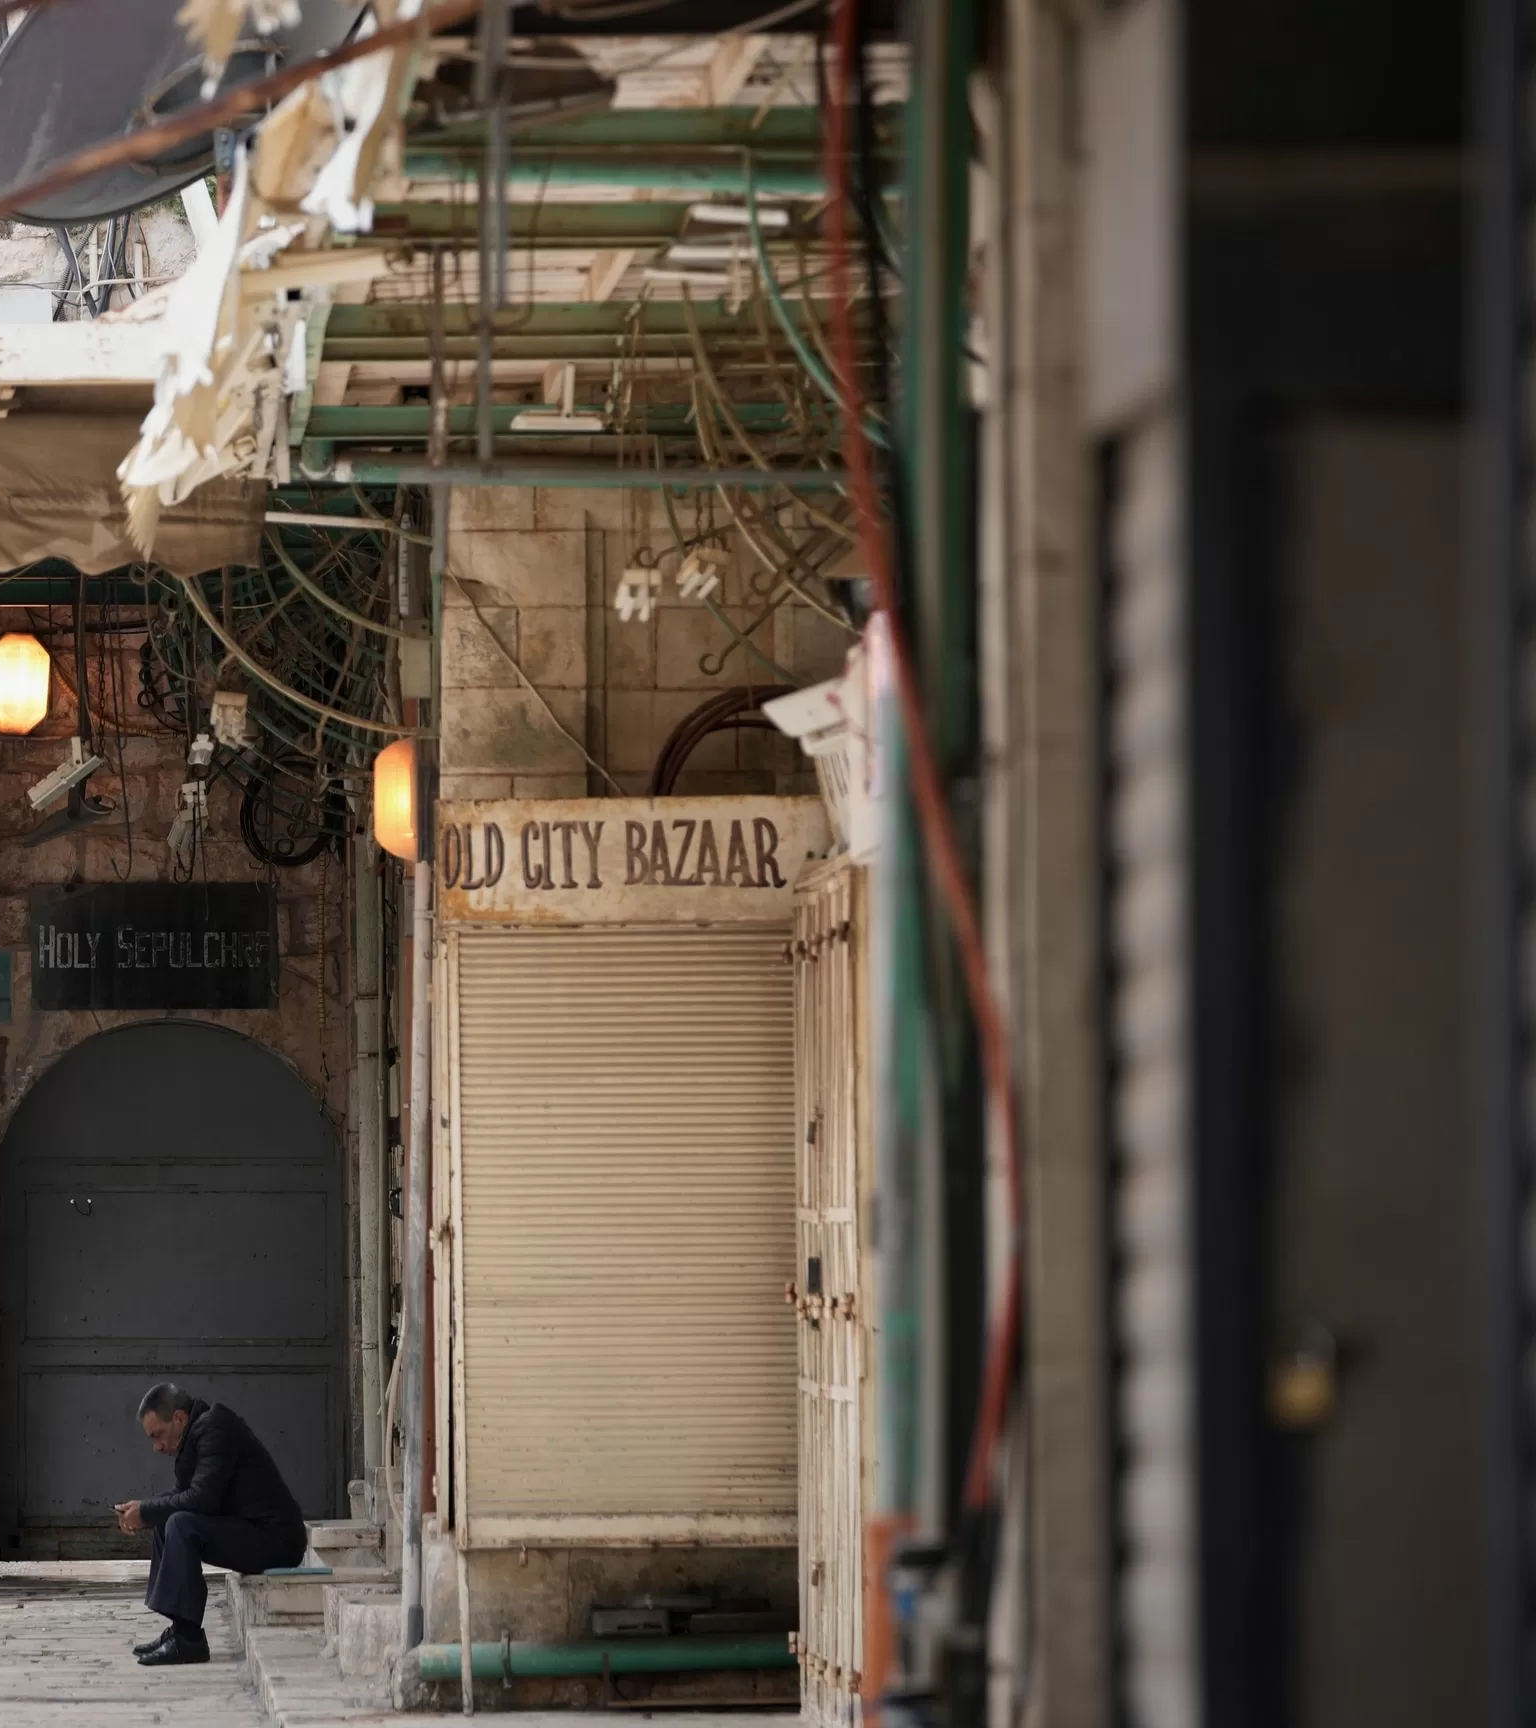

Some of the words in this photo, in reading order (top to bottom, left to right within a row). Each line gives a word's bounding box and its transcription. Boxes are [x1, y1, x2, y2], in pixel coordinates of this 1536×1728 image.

[444, 820, 505, 891] OLD
[521, 819, 604, 890] CITY
[624, 816, 788, 890] BAZAAR
[38, 924, 102, 969] HOLY
